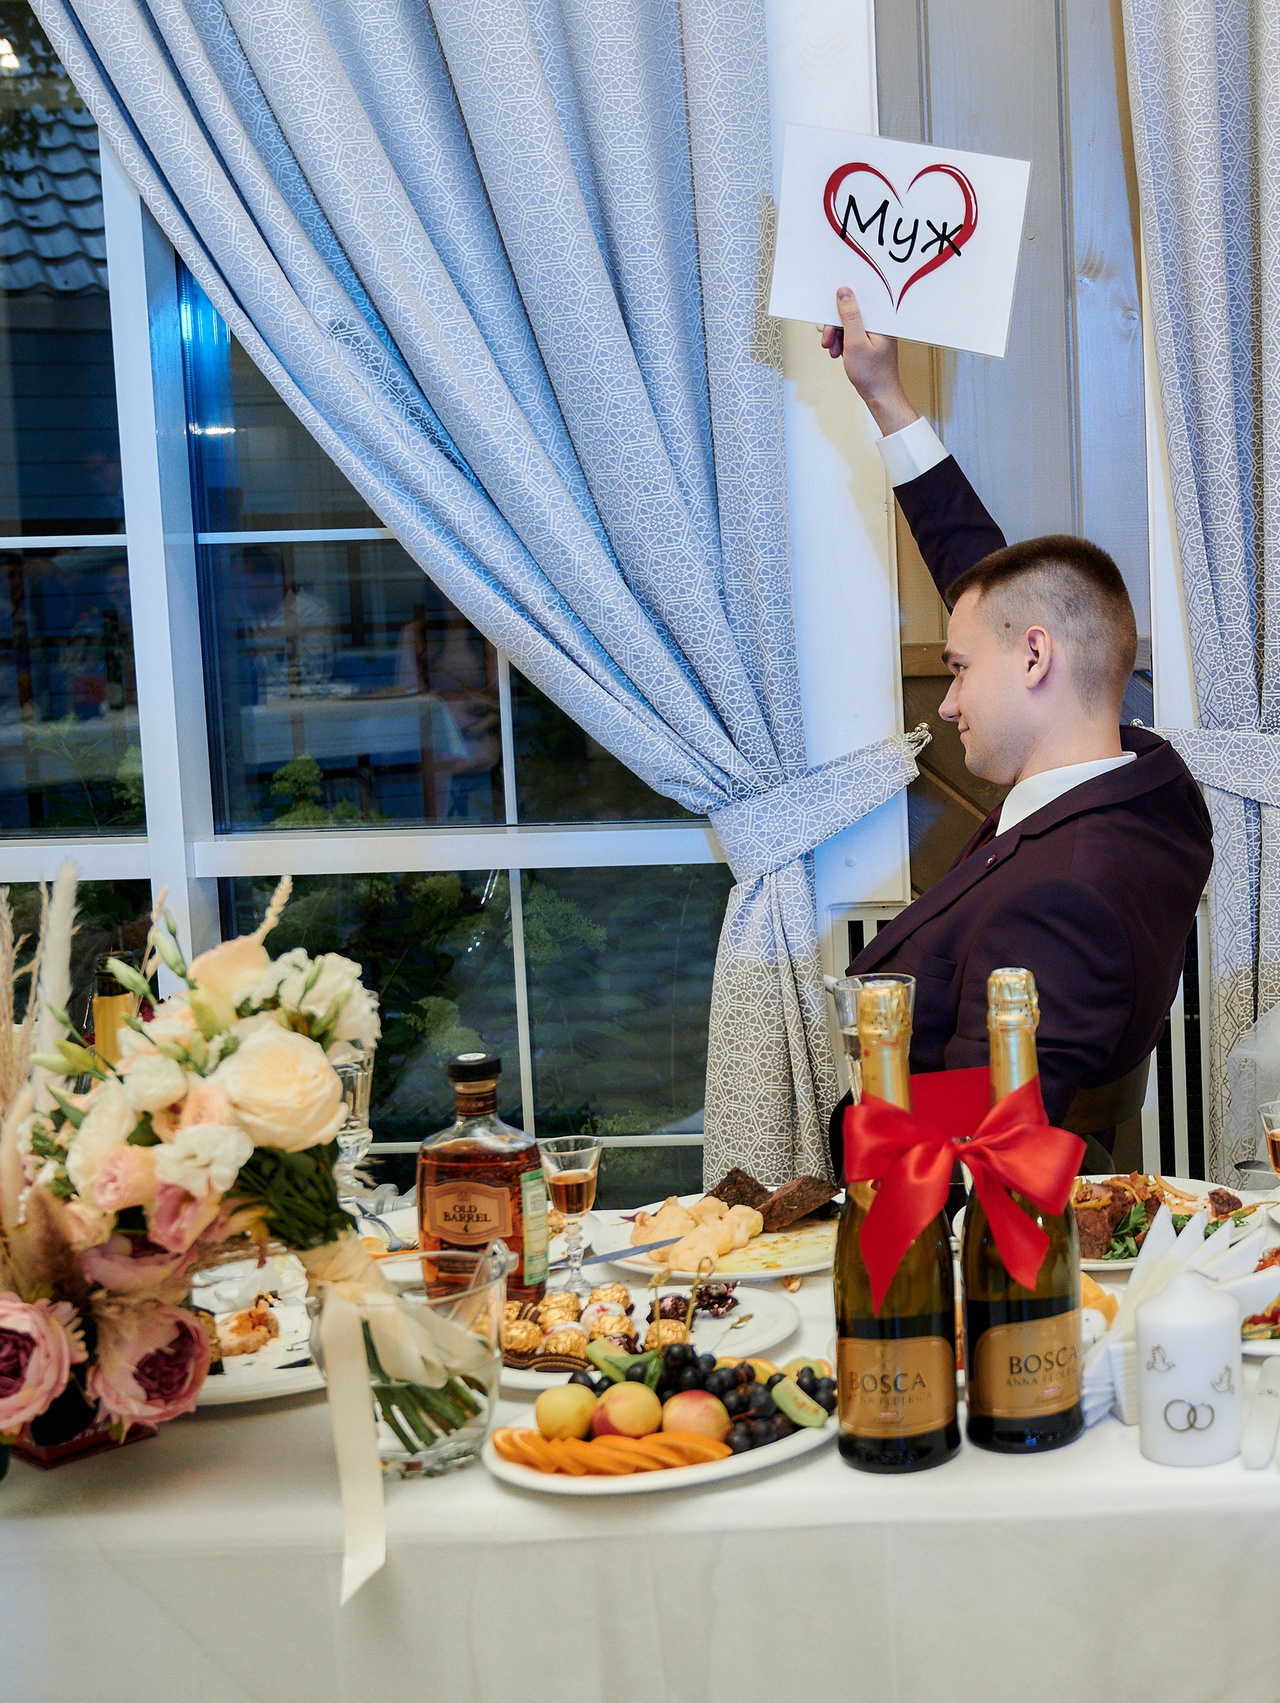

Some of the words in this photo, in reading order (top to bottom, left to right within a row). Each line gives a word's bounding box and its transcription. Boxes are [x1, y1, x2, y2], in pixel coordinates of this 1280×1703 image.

[839, 194, 963, 263] Муж
[443, 1211, 491, 1223] BARREL
[453, 1204, 477, 1213] OLD
[1009, 1343, 1078, 1375] BOSCA
[850, 1371, 926, 1394] BOSCA
